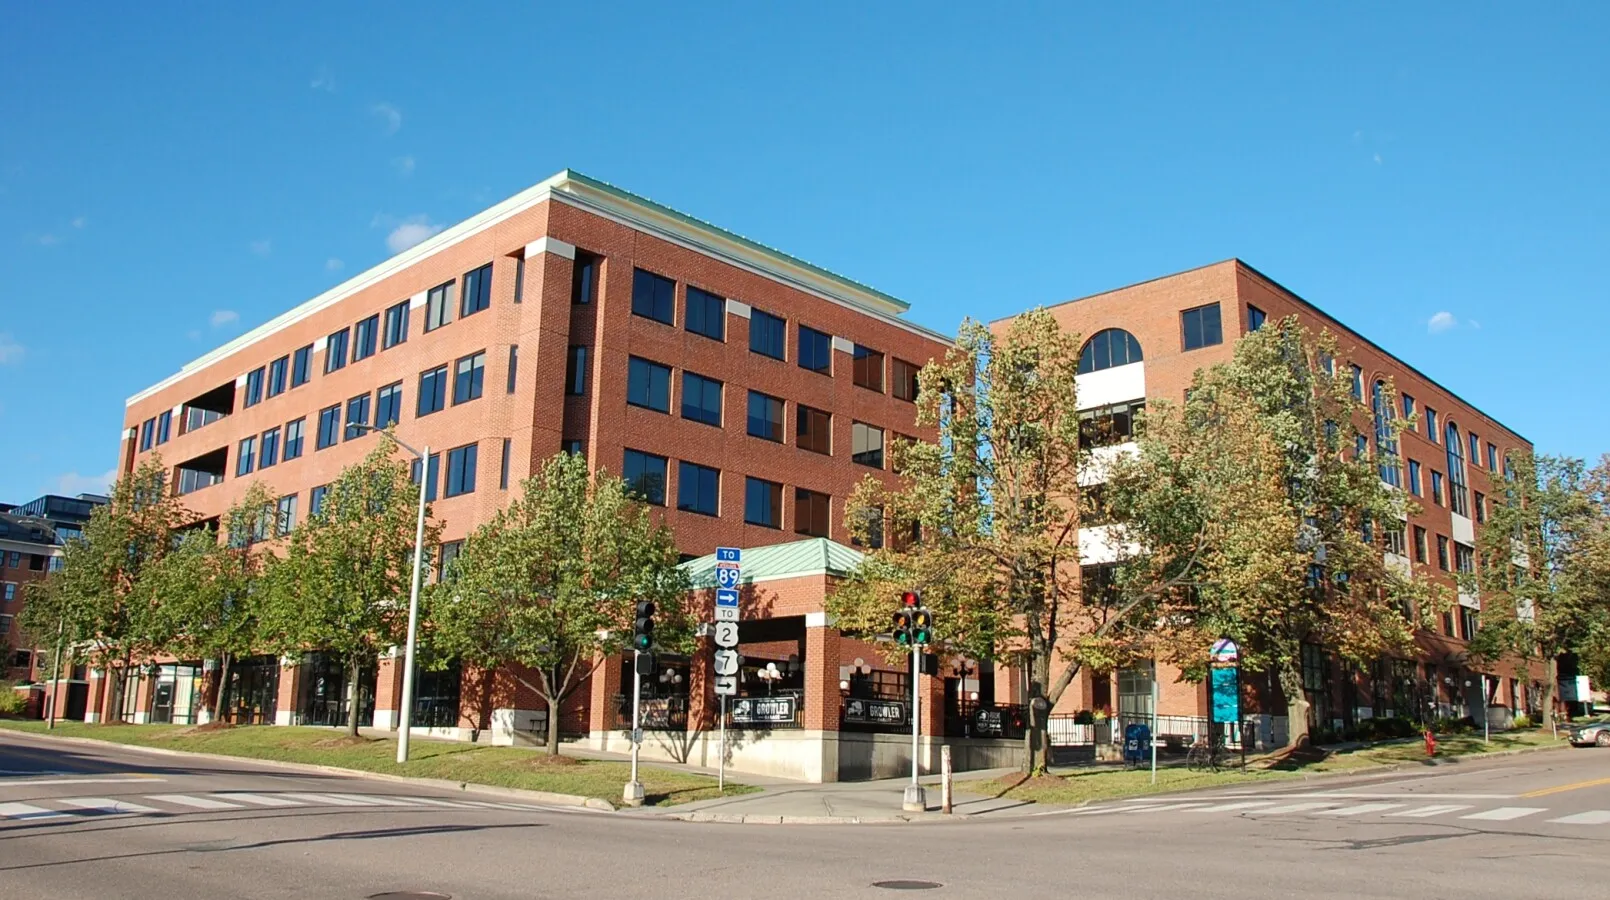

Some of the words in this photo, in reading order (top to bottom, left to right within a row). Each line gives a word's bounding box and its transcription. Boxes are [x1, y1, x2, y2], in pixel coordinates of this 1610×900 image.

[722, 550, 735, 559] TO
[719, 569, 739, 585] 89
[721, 610, 733, 618] TO
[722, 627, 731, 642] 2
[722, 655, 731, 670] 7
[756, 702, 789, 715] GROWLER
[869, 705, 900, 718] GROWLER
